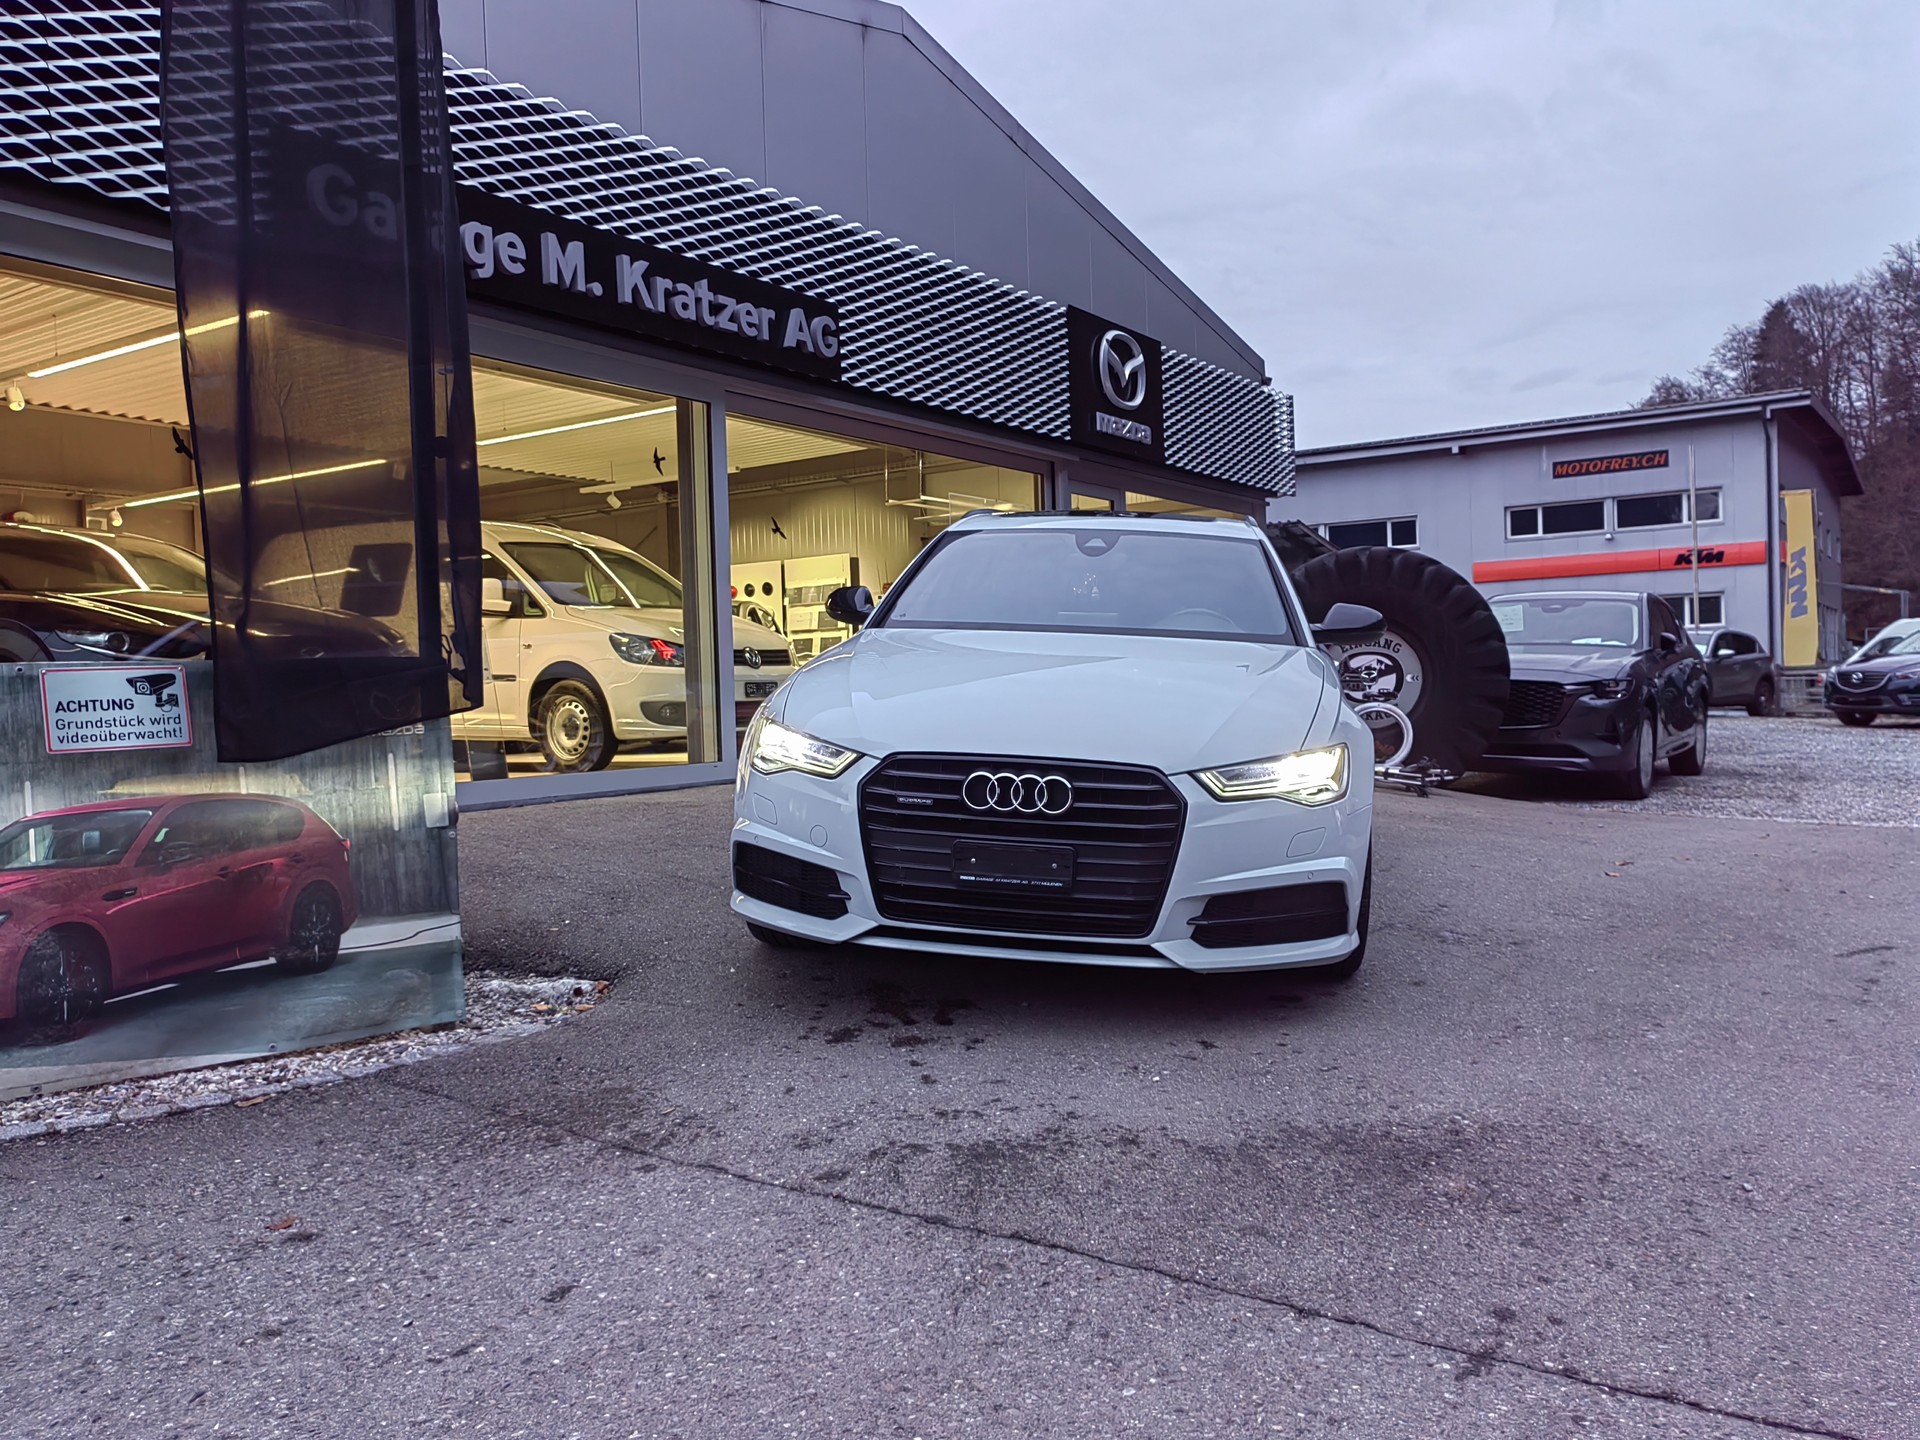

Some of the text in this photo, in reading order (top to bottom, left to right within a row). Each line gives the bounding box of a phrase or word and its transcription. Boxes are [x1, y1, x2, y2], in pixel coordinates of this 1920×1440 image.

[541, 231, 604, 297] M.
[616, 253, 776, 341] Kratzer
[782, 307, 839, 358] AG
[1096, 411, 1152, 445] mazda
[1554, 452, 1668, 476] MOTOFREY.CH
[1674, 547, 1725, 566] KTM
[1787, 546, 1809, 619] KTM
[55, 698, 135, 713] ACHTUNG
[55, 713, 182, 731] Grundstück wird
[57, 727, 183, 744] videoüberwacht!
